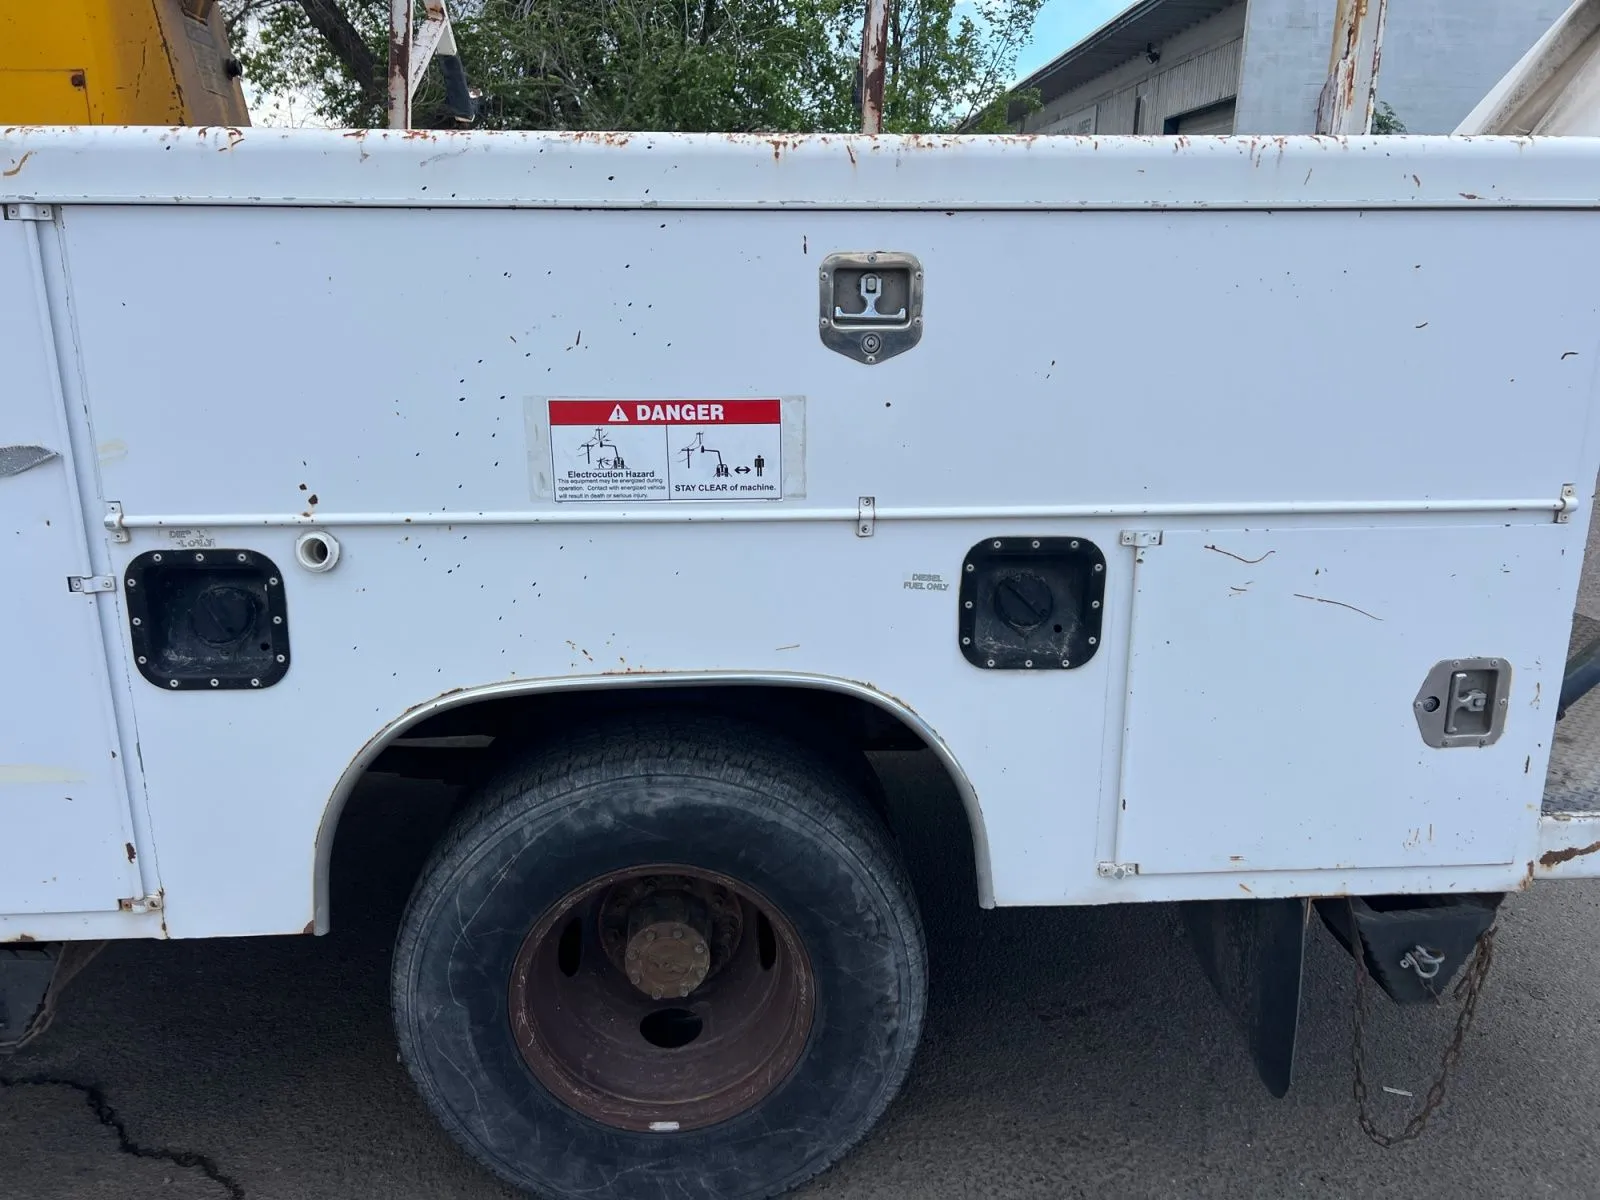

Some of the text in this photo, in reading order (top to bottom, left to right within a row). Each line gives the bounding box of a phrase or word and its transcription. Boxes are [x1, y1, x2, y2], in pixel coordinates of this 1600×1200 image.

[637, 404, 724, 421] DANGER
[567, 470, 655, 479] Electrocution Hazard
[570, 478, 598, 486] equipment
[619, 478, 645, 486] energized
[646, 477, 663, 485] during
[674, 484, 697, 492] STAY
[729, 483, 738, 491] of
[739, 483, 776, 491] machine.
[911, 573, 943, 582] DIESEL
[903, 581, 950, 591] FUEL ONLY
